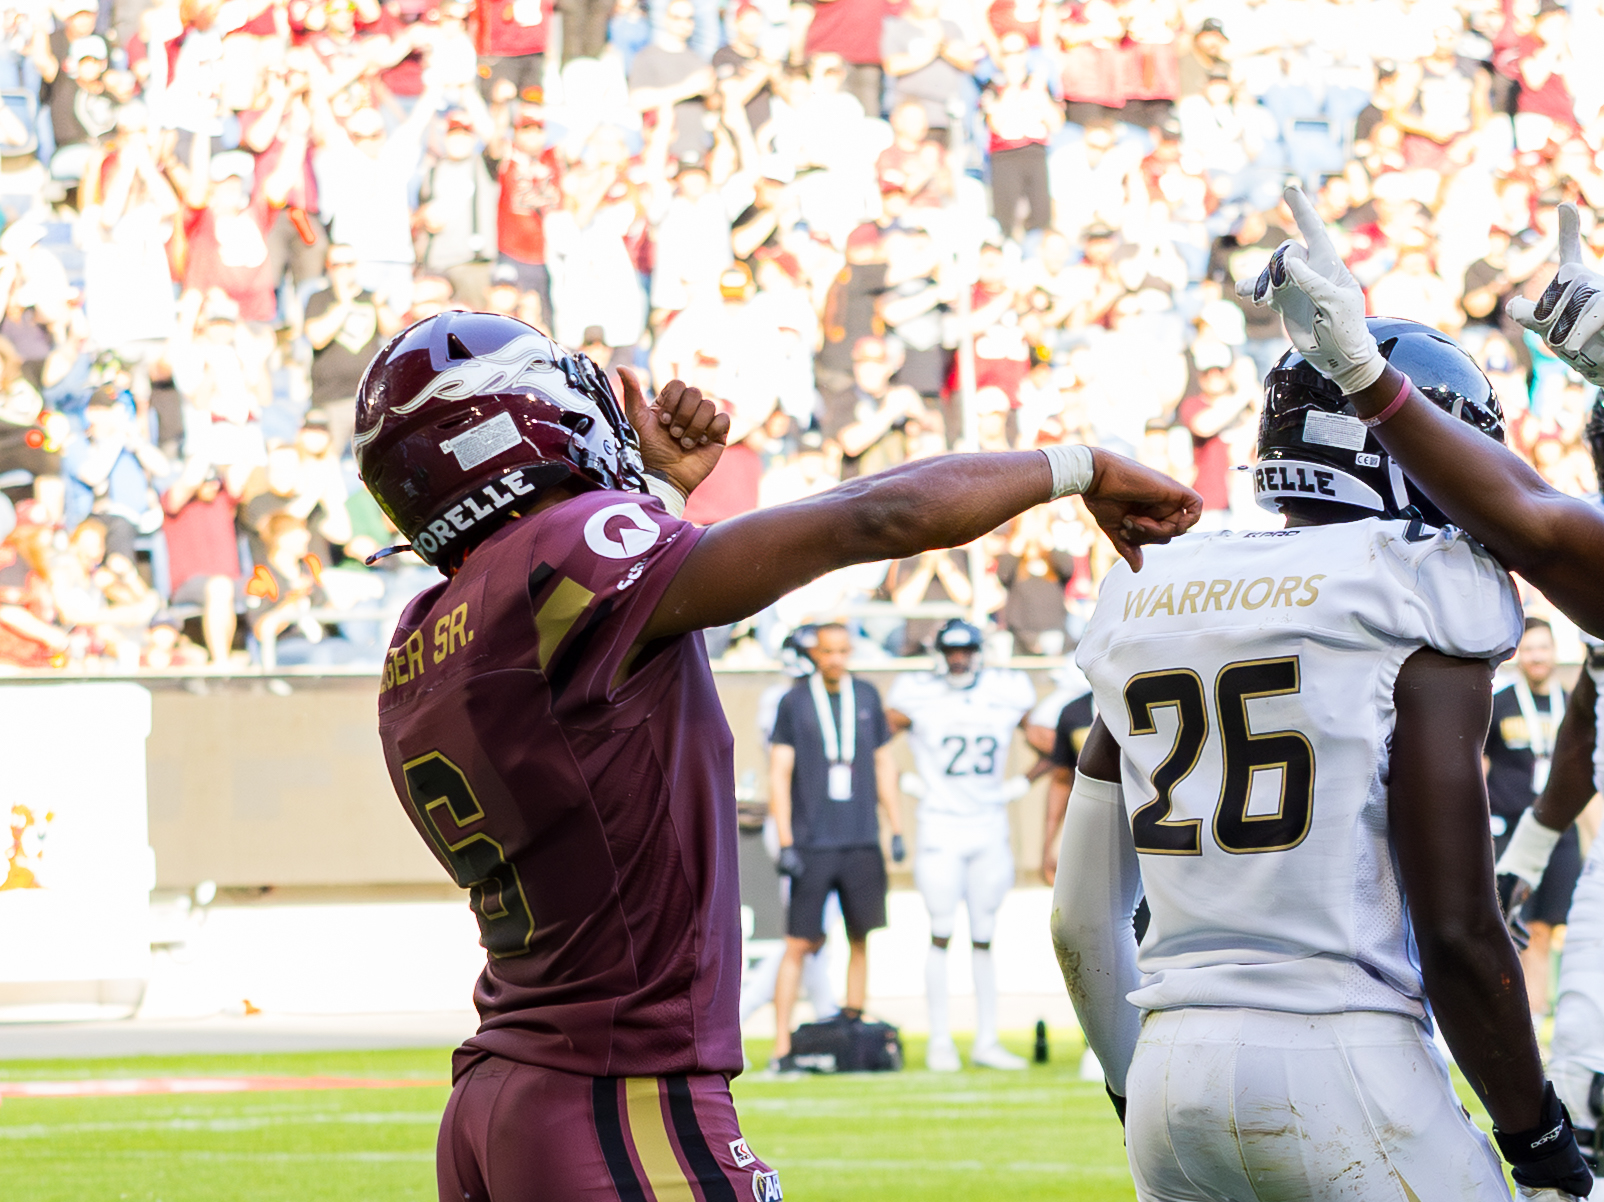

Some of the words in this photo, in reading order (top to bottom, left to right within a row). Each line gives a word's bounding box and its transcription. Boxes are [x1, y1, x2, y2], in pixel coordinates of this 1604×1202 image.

[1122, 573, 1328, 623] WARRIORS
[380, 629, 425, 694] GER
[433, 601, 475, 666] SR.
[940, 734, 1000, 777] 23
[1122, 654, 1316, 856] 26
[402, 748, 536, 960] 6
